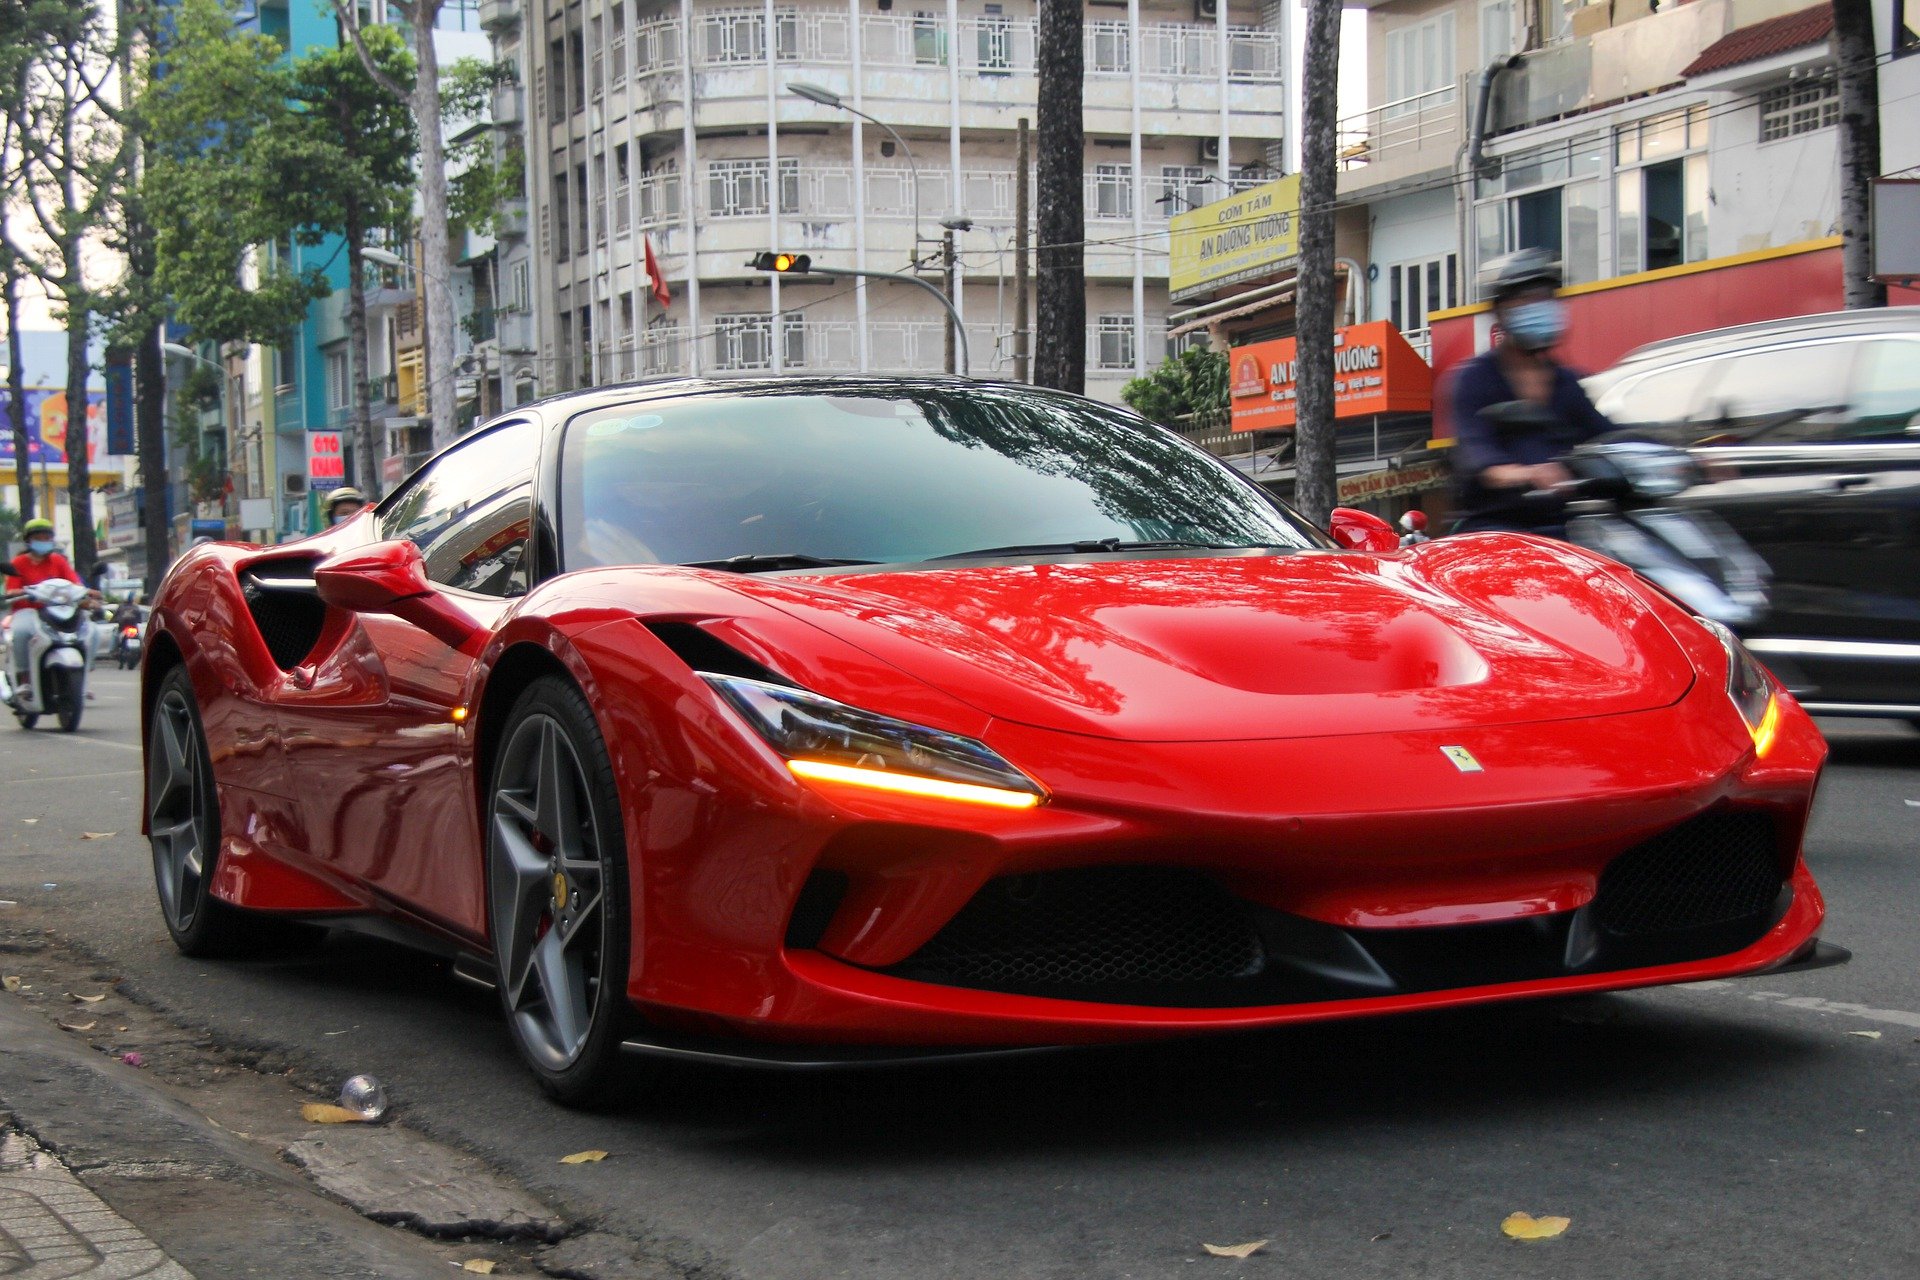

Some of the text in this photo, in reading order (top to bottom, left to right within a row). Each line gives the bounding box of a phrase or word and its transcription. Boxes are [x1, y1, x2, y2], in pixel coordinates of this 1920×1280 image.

[1218, 203, 1243, 223] CƠM
[1200, 236, 1214, 261] AN
[1216, 224, 1251, 255] DƯƠNG
[1270, 361, 1287, 385] AN
[1333, 344, 1379, 373] VƯƠNG
